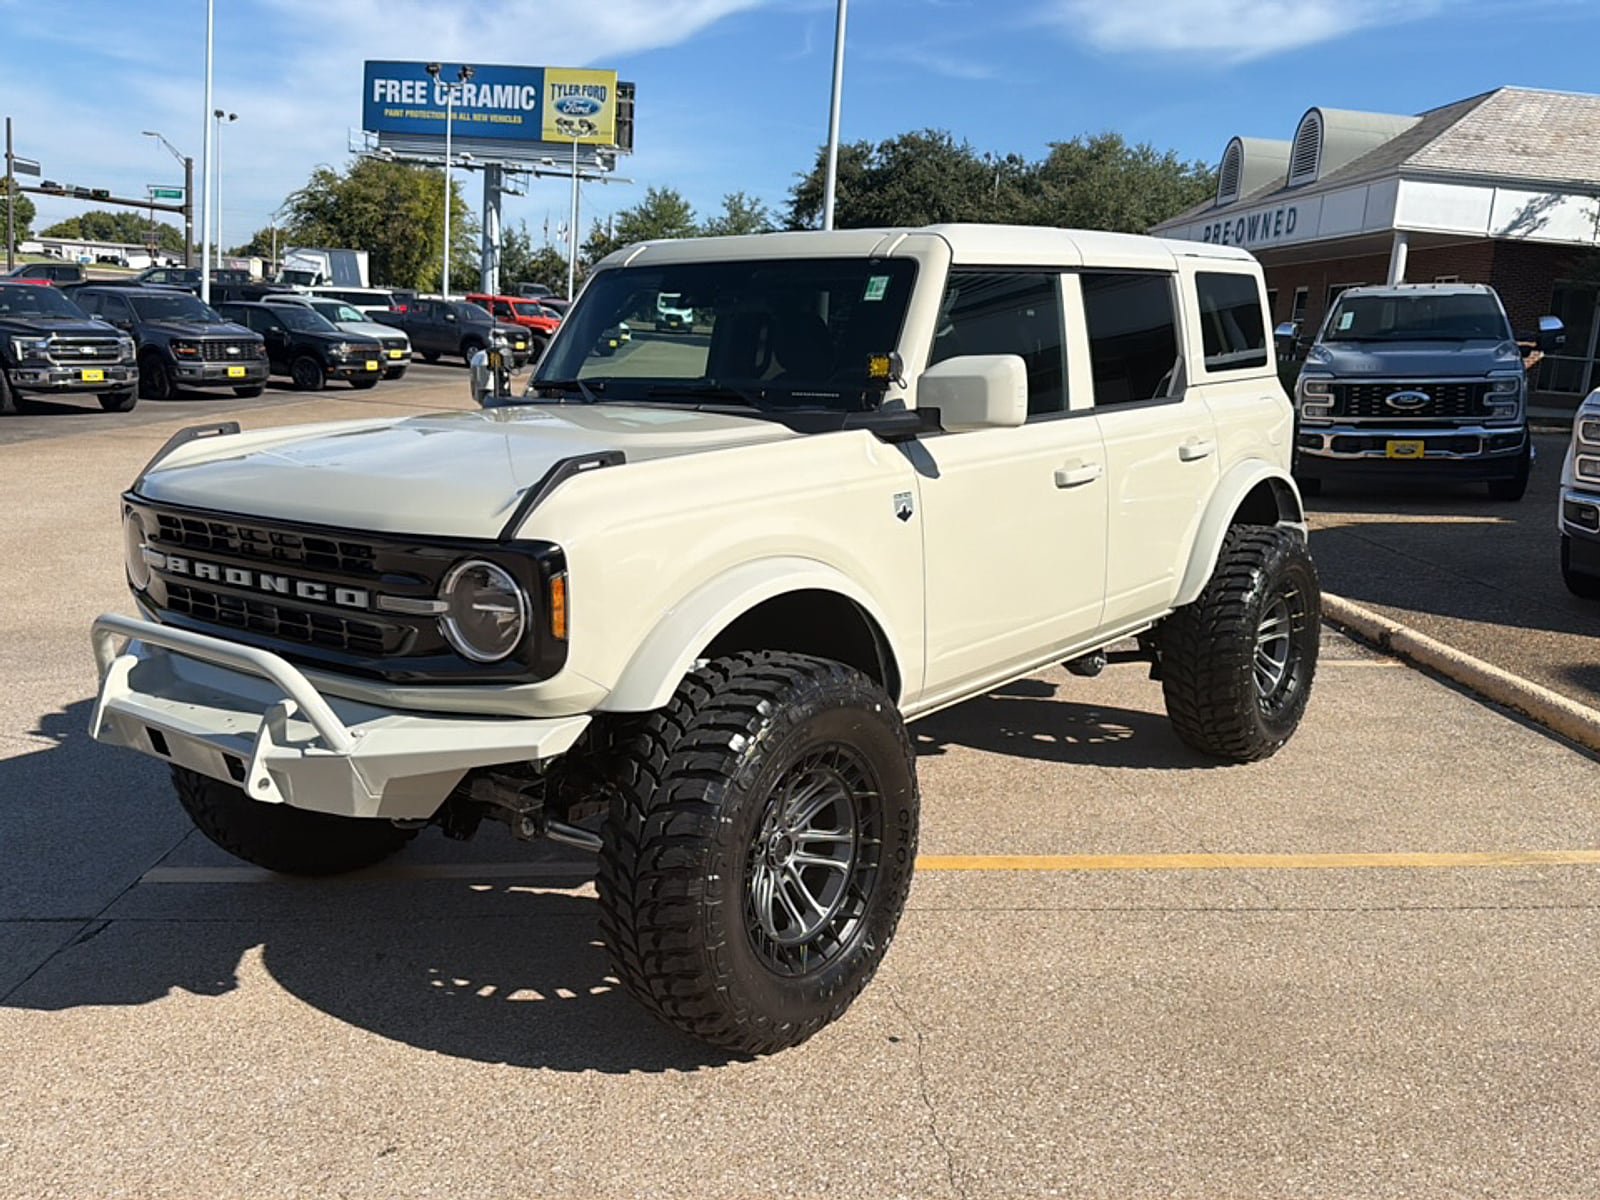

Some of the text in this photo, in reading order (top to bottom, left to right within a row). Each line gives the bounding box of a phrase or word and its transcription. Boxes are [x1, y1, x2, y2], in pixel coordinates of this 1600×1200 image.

[373, 79, 536, 110] FREE CERAMIC
[550, 83, 608, 103] TYLER FORD
[384, 108, 404, 118] PAINT
[405, 110, 446, 120] PROTECTION
[459, 112, 471, 120] ALL
[490, 114, 523, 124] VEHICLES
[563, 99, 592, 113] Ford
[1203, 207, 1297, 245] PRE-OWNED
[166, 556, 370, 609] BRONCO
